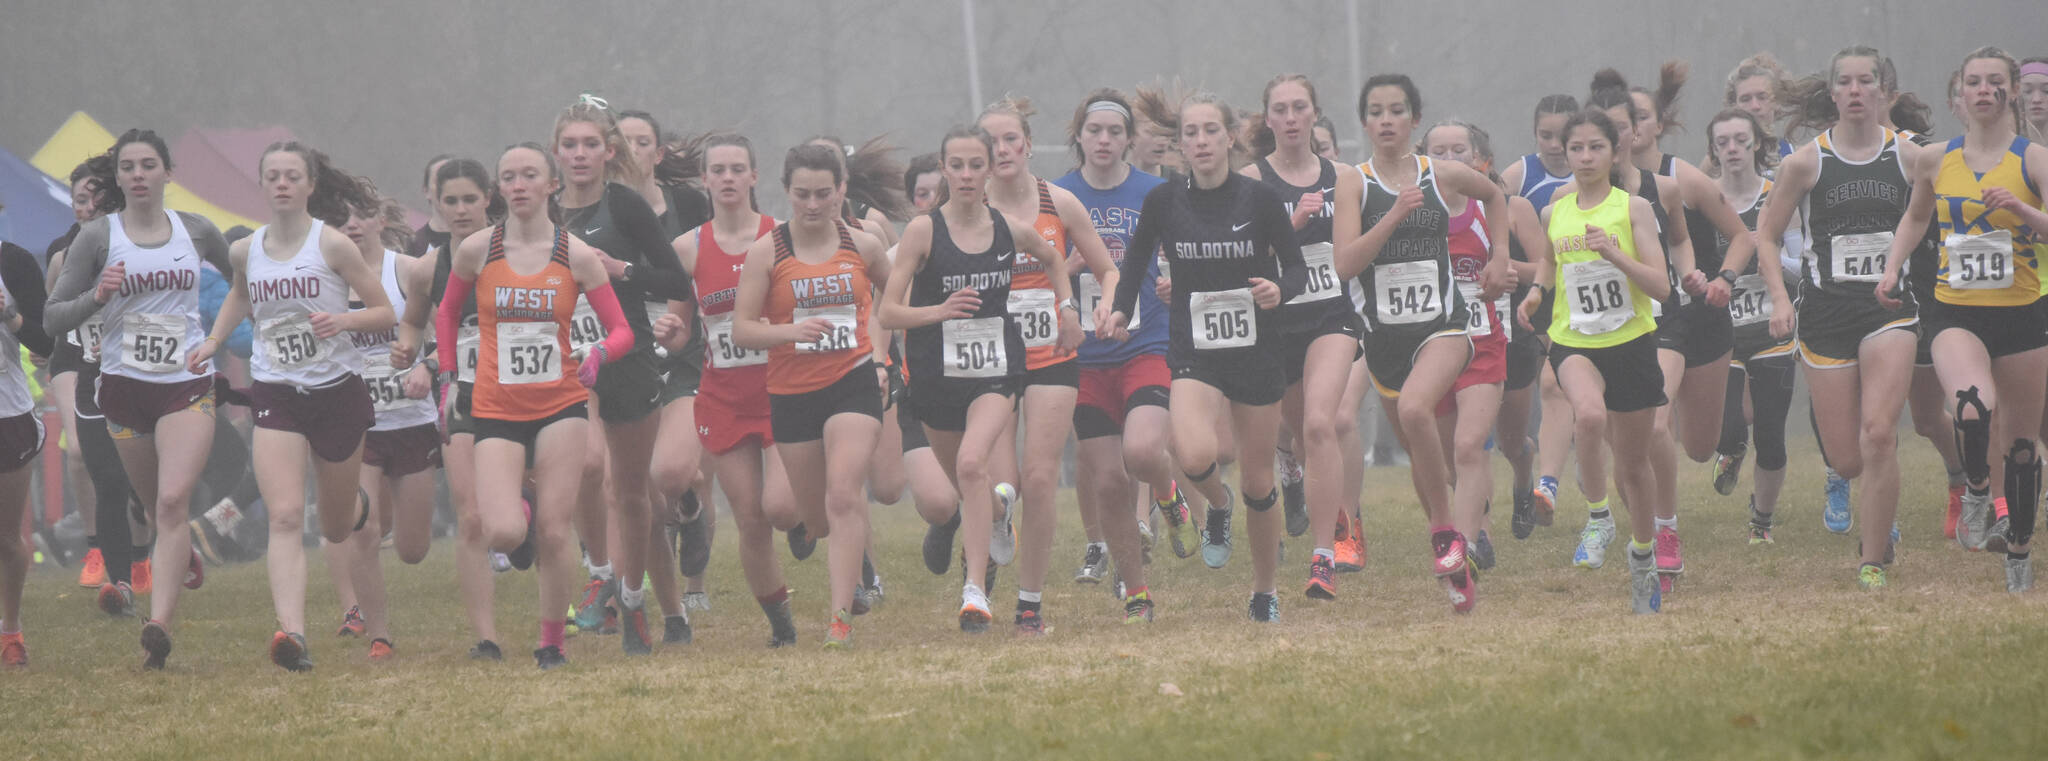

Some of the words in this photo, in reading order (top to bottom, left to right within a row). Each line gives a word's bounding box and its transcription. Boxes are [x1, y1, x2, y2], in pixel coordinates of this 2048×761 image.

[1825, 180, 1898, 208] SERVICE
[1176, 240, 1254, 259] SOLDOTNA
[1960, 253, 2005, 281] 519
[250, 276, 320, 304] DIMOND
[495, 286, 557, 310] WEST
[791, 272, 853, 299] WEST
[1389, 284, 1435, 316] 542
[1577, 280, 1623, 314] 518
[1729, 290, 1766, 319] 547
[1204, 309, 1250, 340] 505
[134, 334, 178, 364] 552
[275, 331, 317, 364] 550
[510, 344, 553, 375] 537
[956, 341, 1000, 370] 504
